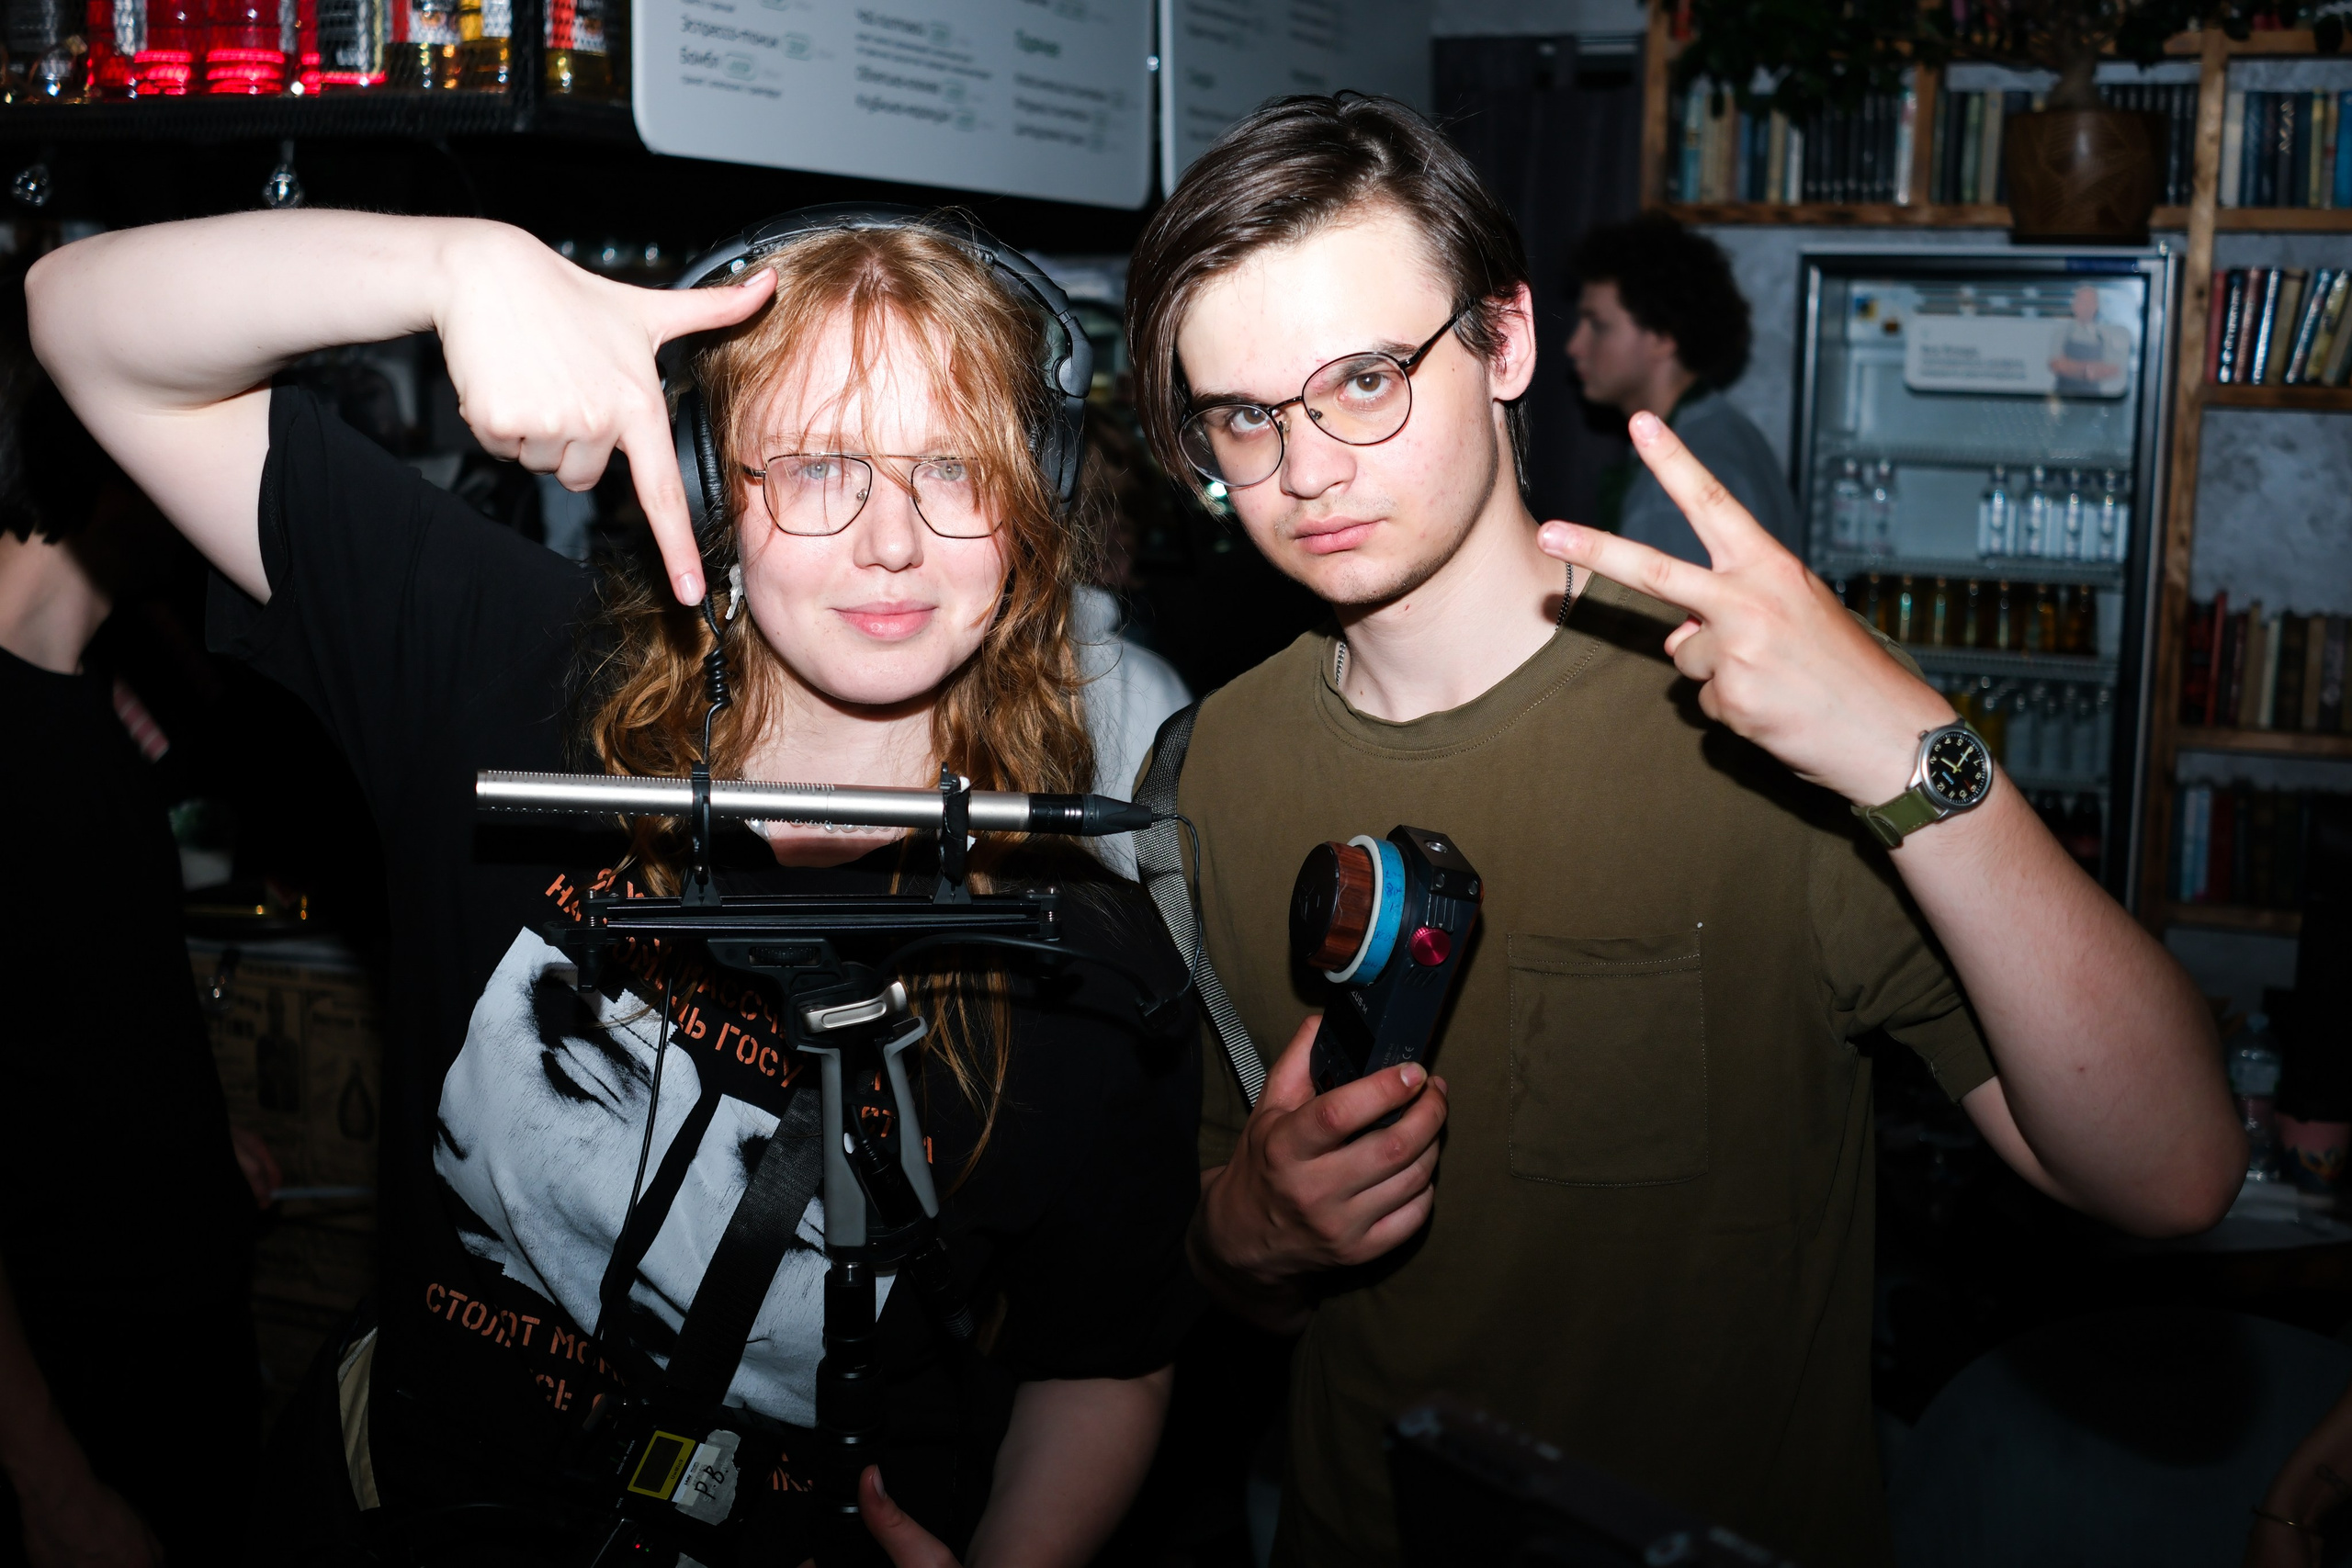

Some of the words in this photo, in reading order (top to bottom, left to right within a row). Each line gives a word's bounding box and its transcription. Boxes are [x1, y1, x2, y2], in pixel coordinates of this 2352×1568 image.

[1956, 739, 1963, 747] 5
[1934, 744, 1941, 752] 3
[1929, 756, 1937, 764] 2
[1937, 782, 1945, 792] 12
[1970, 784, 1977, 793] 9
[1959, 790, 1968, 799] 10
